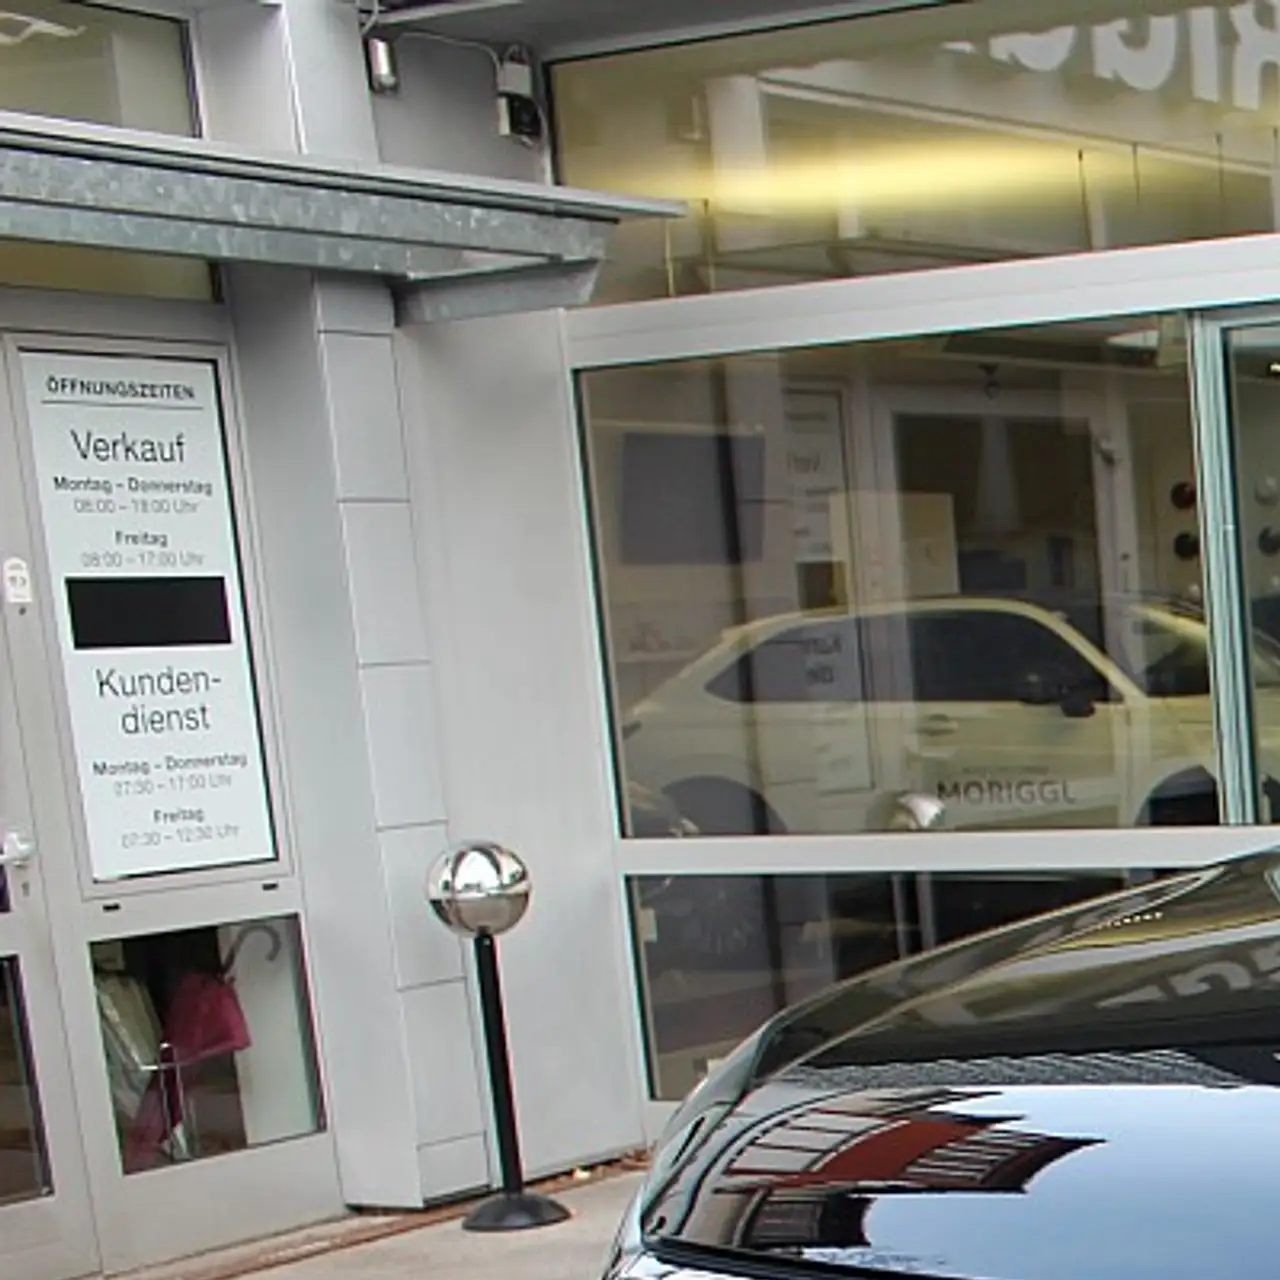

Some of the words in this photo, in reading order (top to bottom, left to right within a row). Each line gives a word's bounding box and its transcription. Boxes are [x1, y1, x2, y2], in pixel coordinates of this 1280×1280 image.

[47, 375, 196, 399] ÖFFNUNGSZEITEN
[70, 429, 185, 463] Verkauf
[53, 476, 113, 494] Montag
[127, 476, 213, 496] Donnerstag
[173, 499, 200, 514] Uhr
[115, 530, 168, 548] Freitag
[180, 552, 205, 567] Uhr
[96, 666, 222, 698] Kunden-
[121, 703, 210, 735] dienst
[92, 761, 151, 776] Montag
[165, 753, 248, 770] Donnerstag
[936, 780, 1077, 805] MORIGGL
[153, 808, 205, 824] Freitag
